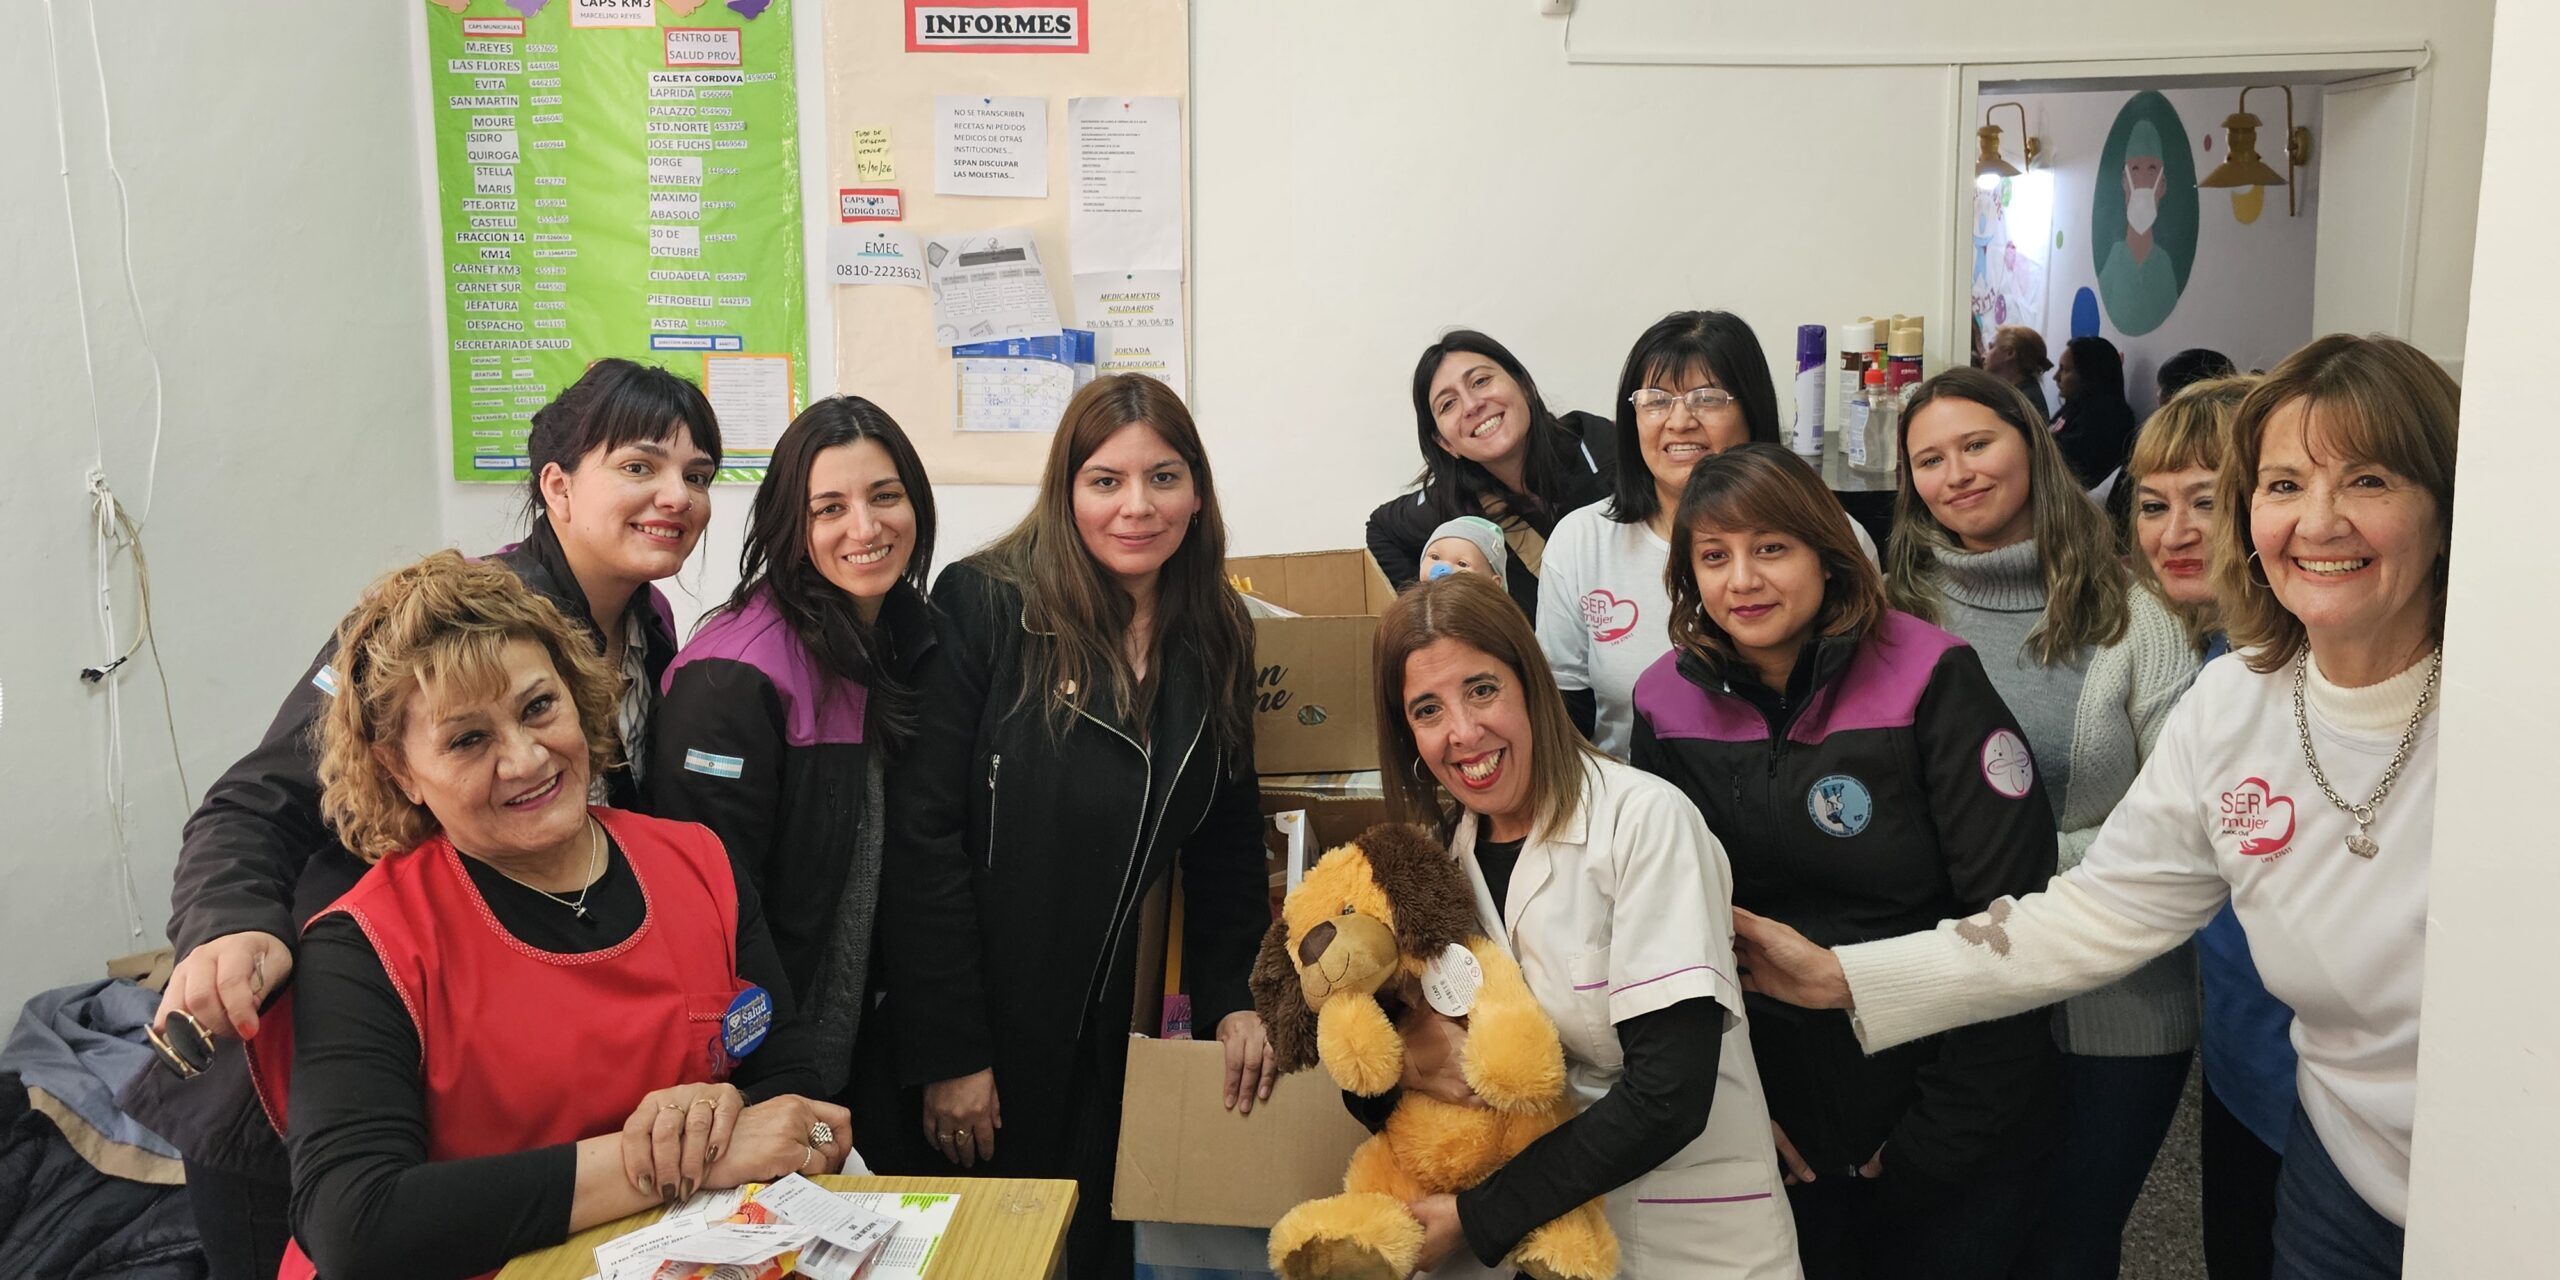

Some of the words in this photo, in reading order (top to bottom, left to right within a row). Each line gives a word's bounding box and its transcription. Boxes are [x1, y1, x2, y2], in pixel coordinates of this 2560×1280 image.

[620, 12, 641, 20] REYES
[924, 14, 1072, 34] INFORMES
[668, 33, 711, 43] CENTRO
[713, 33, 728, 43] DE
[466, 42, 512, 53] M.REYES
[669, 51, 704, 60] SALUD
[707, 51, 740, 61] PROV.
[452, 61, 473, 71] LAS
[476, 61, 520, 72] FLORES
[653, 75, 691, 83] CALETA
[694, 75, 743, 83] CORDOVA
[475, 80, 505, 89] EVITA
[650, 89, 695, 98] LAPRIDA
[451, 97, 472, 106] SAN
[475, 97, 518, 106] MARTIN
[650, 107, 696, 116] PALAZZO
[474, 118, 514, 127] MOURE
[649, 123, 709, 132] STD.NORTE
[467, 133, 502, 142] ISIDRO
[649, 140, 673, 149] JOSE
[677, 141, 711, 150] FUCHS
[468, 151, 519, 160] QUIROGA
[650, 158, 683, 167] JORGE
[979, 160, 1019, 168] DISCULPAR
[476, 167, 512, 176] STELLA
[650, 175, 702, 185] NEWBERY
[478, 185, 512, 194] MARIS
[650, 193, 698, 203] MAXIMO
[463, 200, 516, 210] PTE.ORTIZ
[650, 211, 700, 220] ABASOLO
[471, 218, 516, 227] CASTELLI
[457, 233, 510, 242] FRACCION
[513, 233, 525, 241] 14
[651, 229, 663, 238] 30
[666, 230, 680, 239] DE
[651, 247, 699, 256] OCTUBRE
[865, 241, 900, 254] EMEC
[481, 250, 511, 259] KM14
[453, 264, 496, 273] CARNET
[498, 265, 521, 275] KM3
[836, 264, 922, 280] 0810-2223632
[650, 272, 710, 280] CIUDADELA
[457, 283, 497, 292] CARNET
[501, 283, 521, 292] SUR
[648, 294, 711, 307] PIETROBELLI
[1100, 292, 1161, 300] MEDICAMENTOS
[466, 301, 518, 311] JEFATURA
[467, 321, 523, 331] DESPACHO
[654, 319, 688, 329] ASTRA
[1128, 319, 1135, 327] Y
[536, 340, 570, 349] SALUD
[1115, 347, 1151, 355] JORNADA
[1101, 361, 1166, 369] OFTALMOLOGICA
[1580, 595, 1607, 614] SER
[1583, 613, 1614, 626] mujer
[2220, 791, 2261, 815] SER
[2221, 815, 2269, 832] mujer
[742, 1000, 767, 1024] Salud
